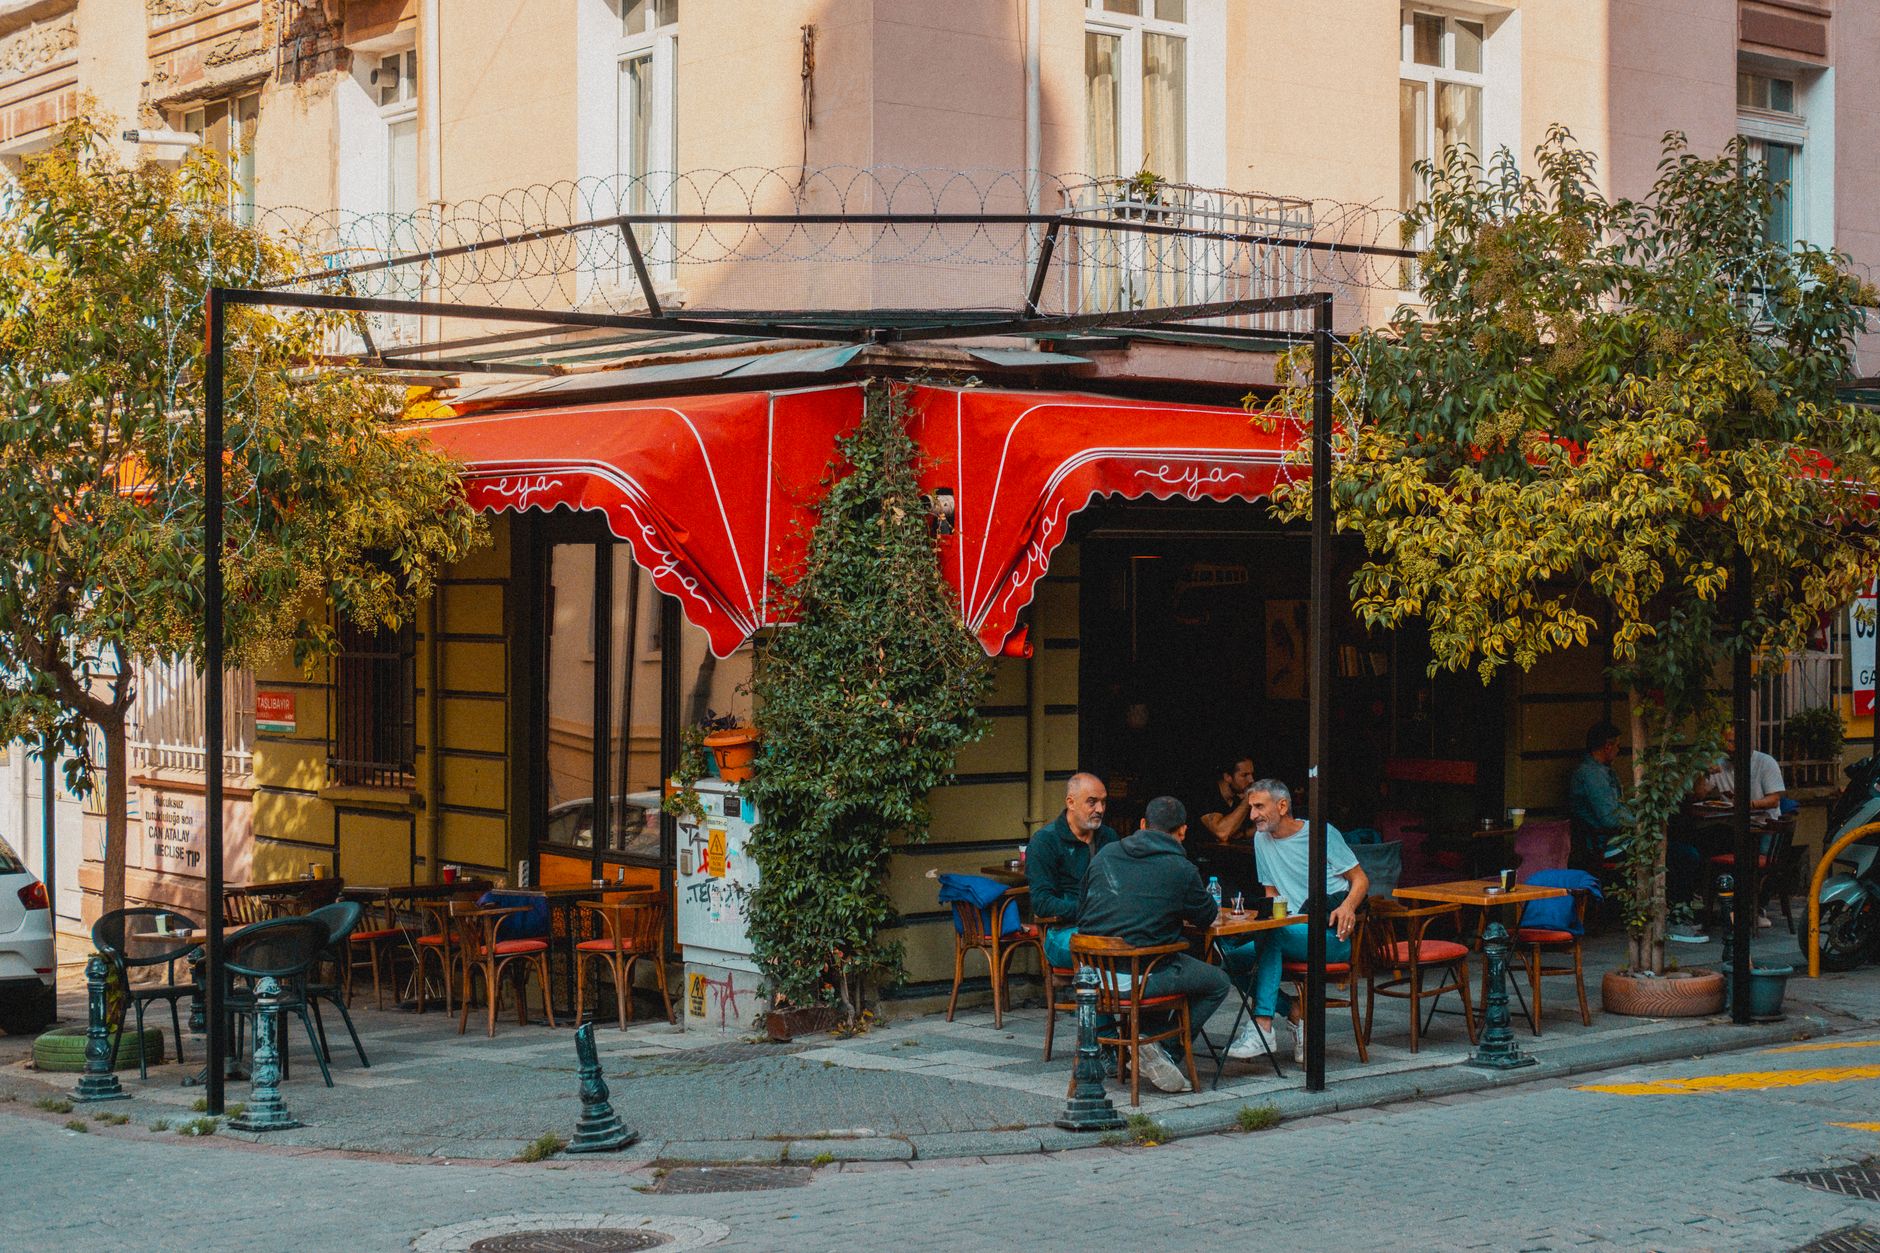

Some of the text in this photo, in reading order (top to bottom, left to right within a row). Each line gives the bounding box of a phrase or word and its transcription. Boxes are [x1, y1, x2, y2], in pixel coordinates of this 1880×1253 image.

[482, 475, 563, 510] eya
[1134, 465, 1245, 499] eya
[620, 504, 713, 614] eya
[1003, 498, 1065, 613] eya
[148, 826, 190, 842] CAN ATALAY
